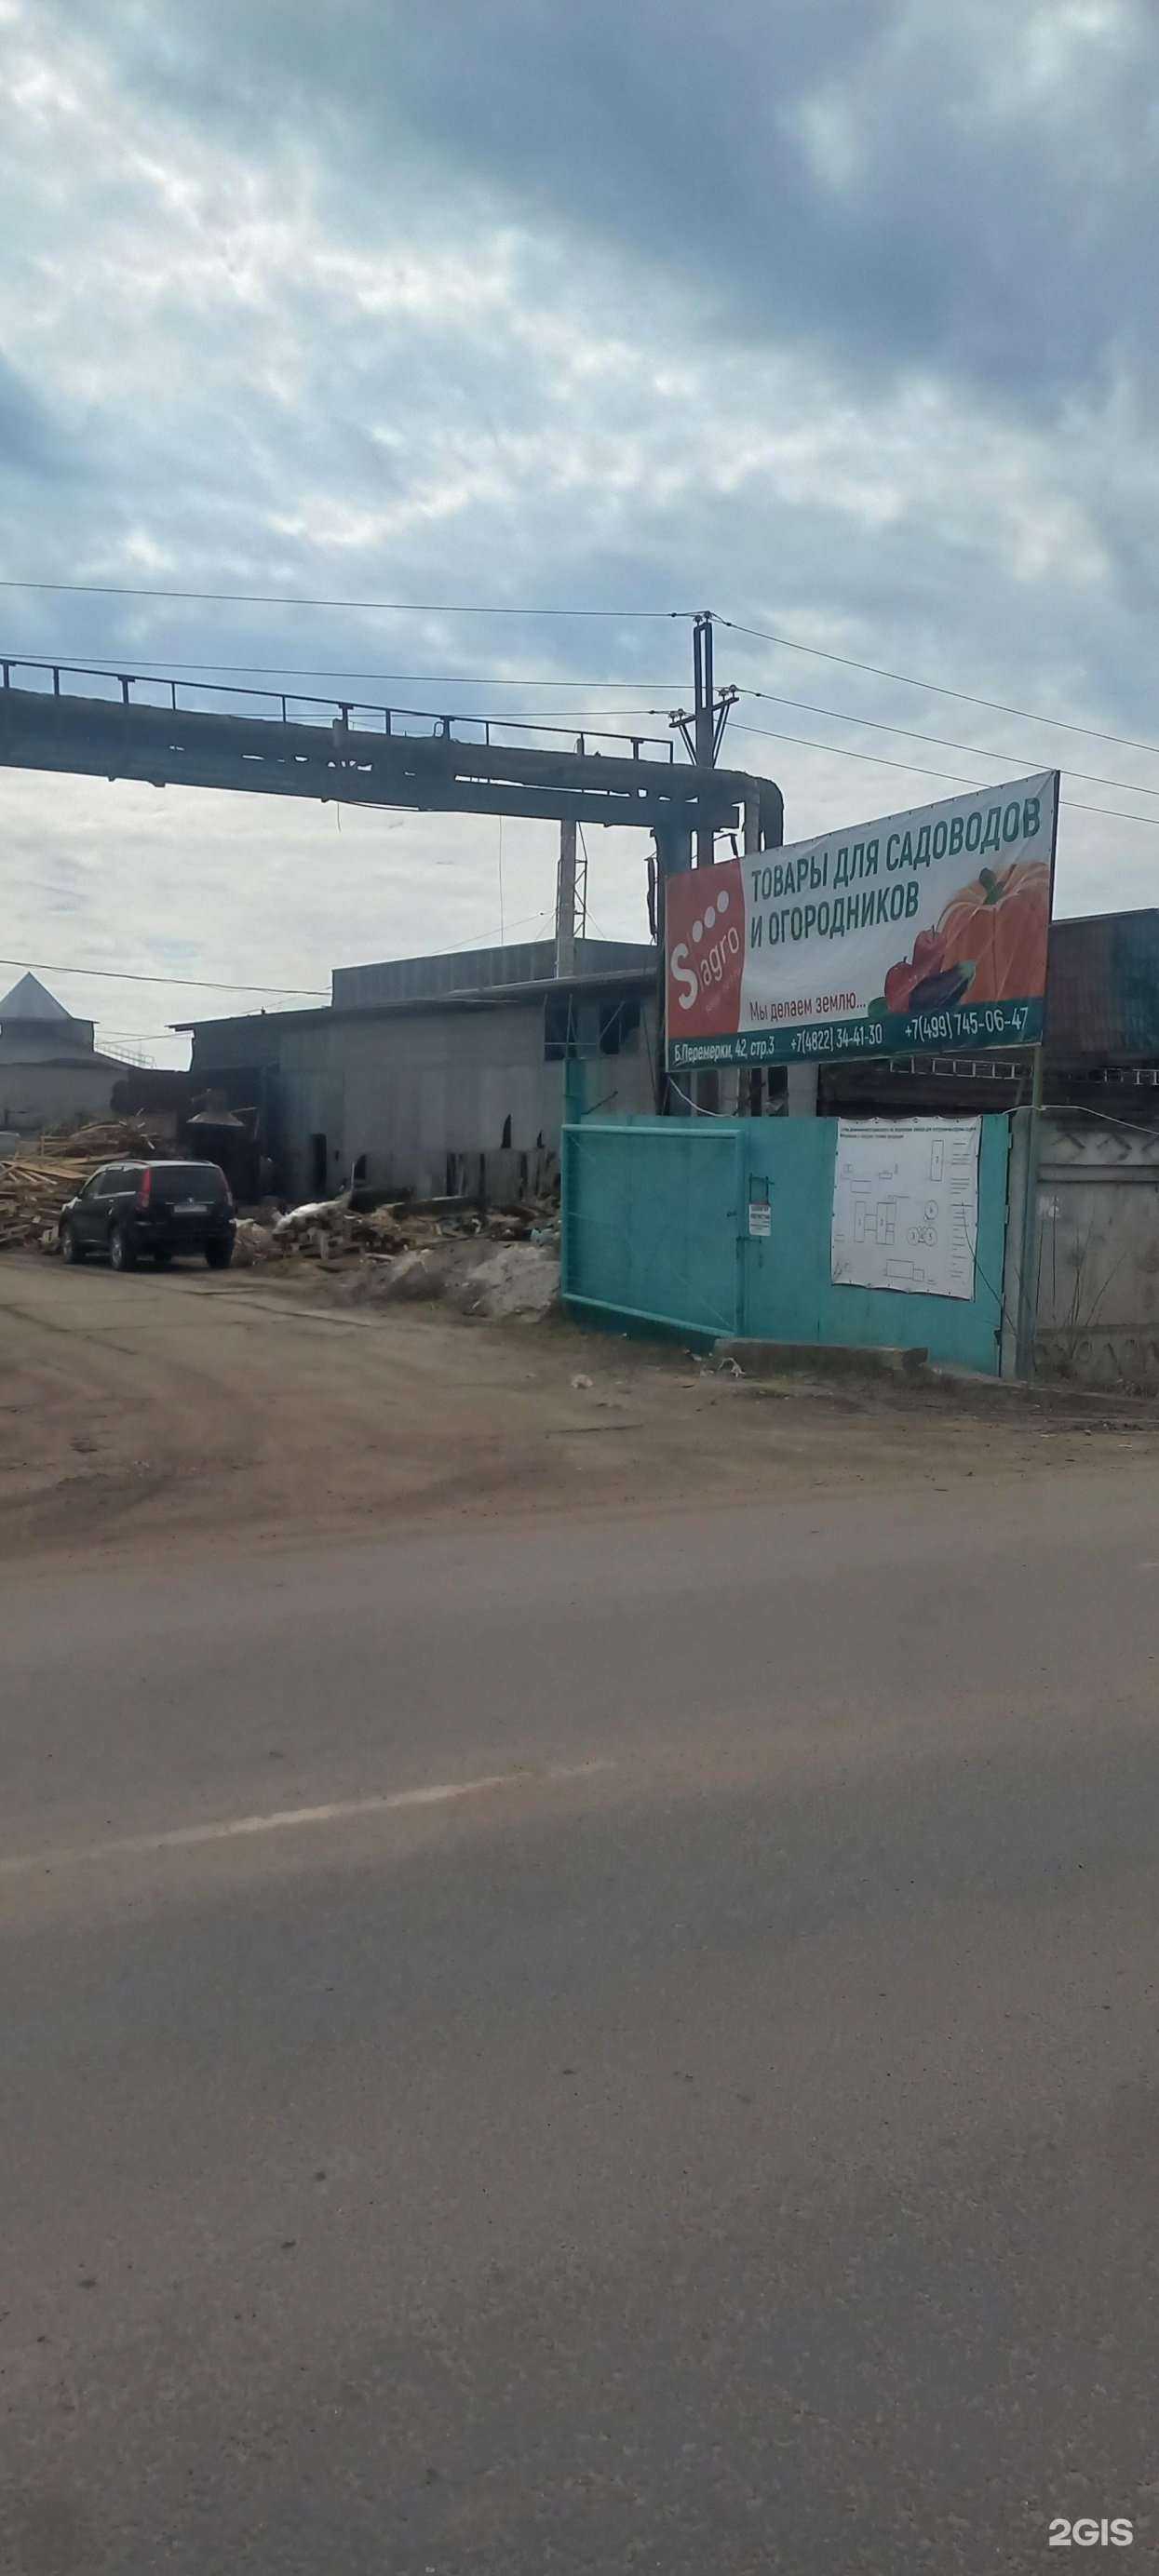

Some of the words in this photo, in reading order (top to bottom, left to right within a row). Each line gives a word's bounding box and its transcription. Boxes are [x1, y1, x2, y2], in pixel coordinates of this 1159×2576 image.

[751, 852, 828, 902] ТОВАРЫ
[833, 839, 880, 889] ДЛЯ
[886, 798, 1041, 871] САДОВОДОВ
[750, 915, 763, 948] И
[768, 881, 920, 940] ОГОРОДНИКОВ
[749, 1000, 768, 1021] Мы
[771, 999, 813, 1023] делаем
[815, 992, 866, 1013] землю...
[790, 1026, 834, 1054] +7(4822)
[837, 1023, 883, 1048] 34-41-30
[905, 1012, 953, 1042] +7(499)
[954, 1007, 1029, 1036] 745-06-47
[750, 1036, 775, 1059] стр.3
